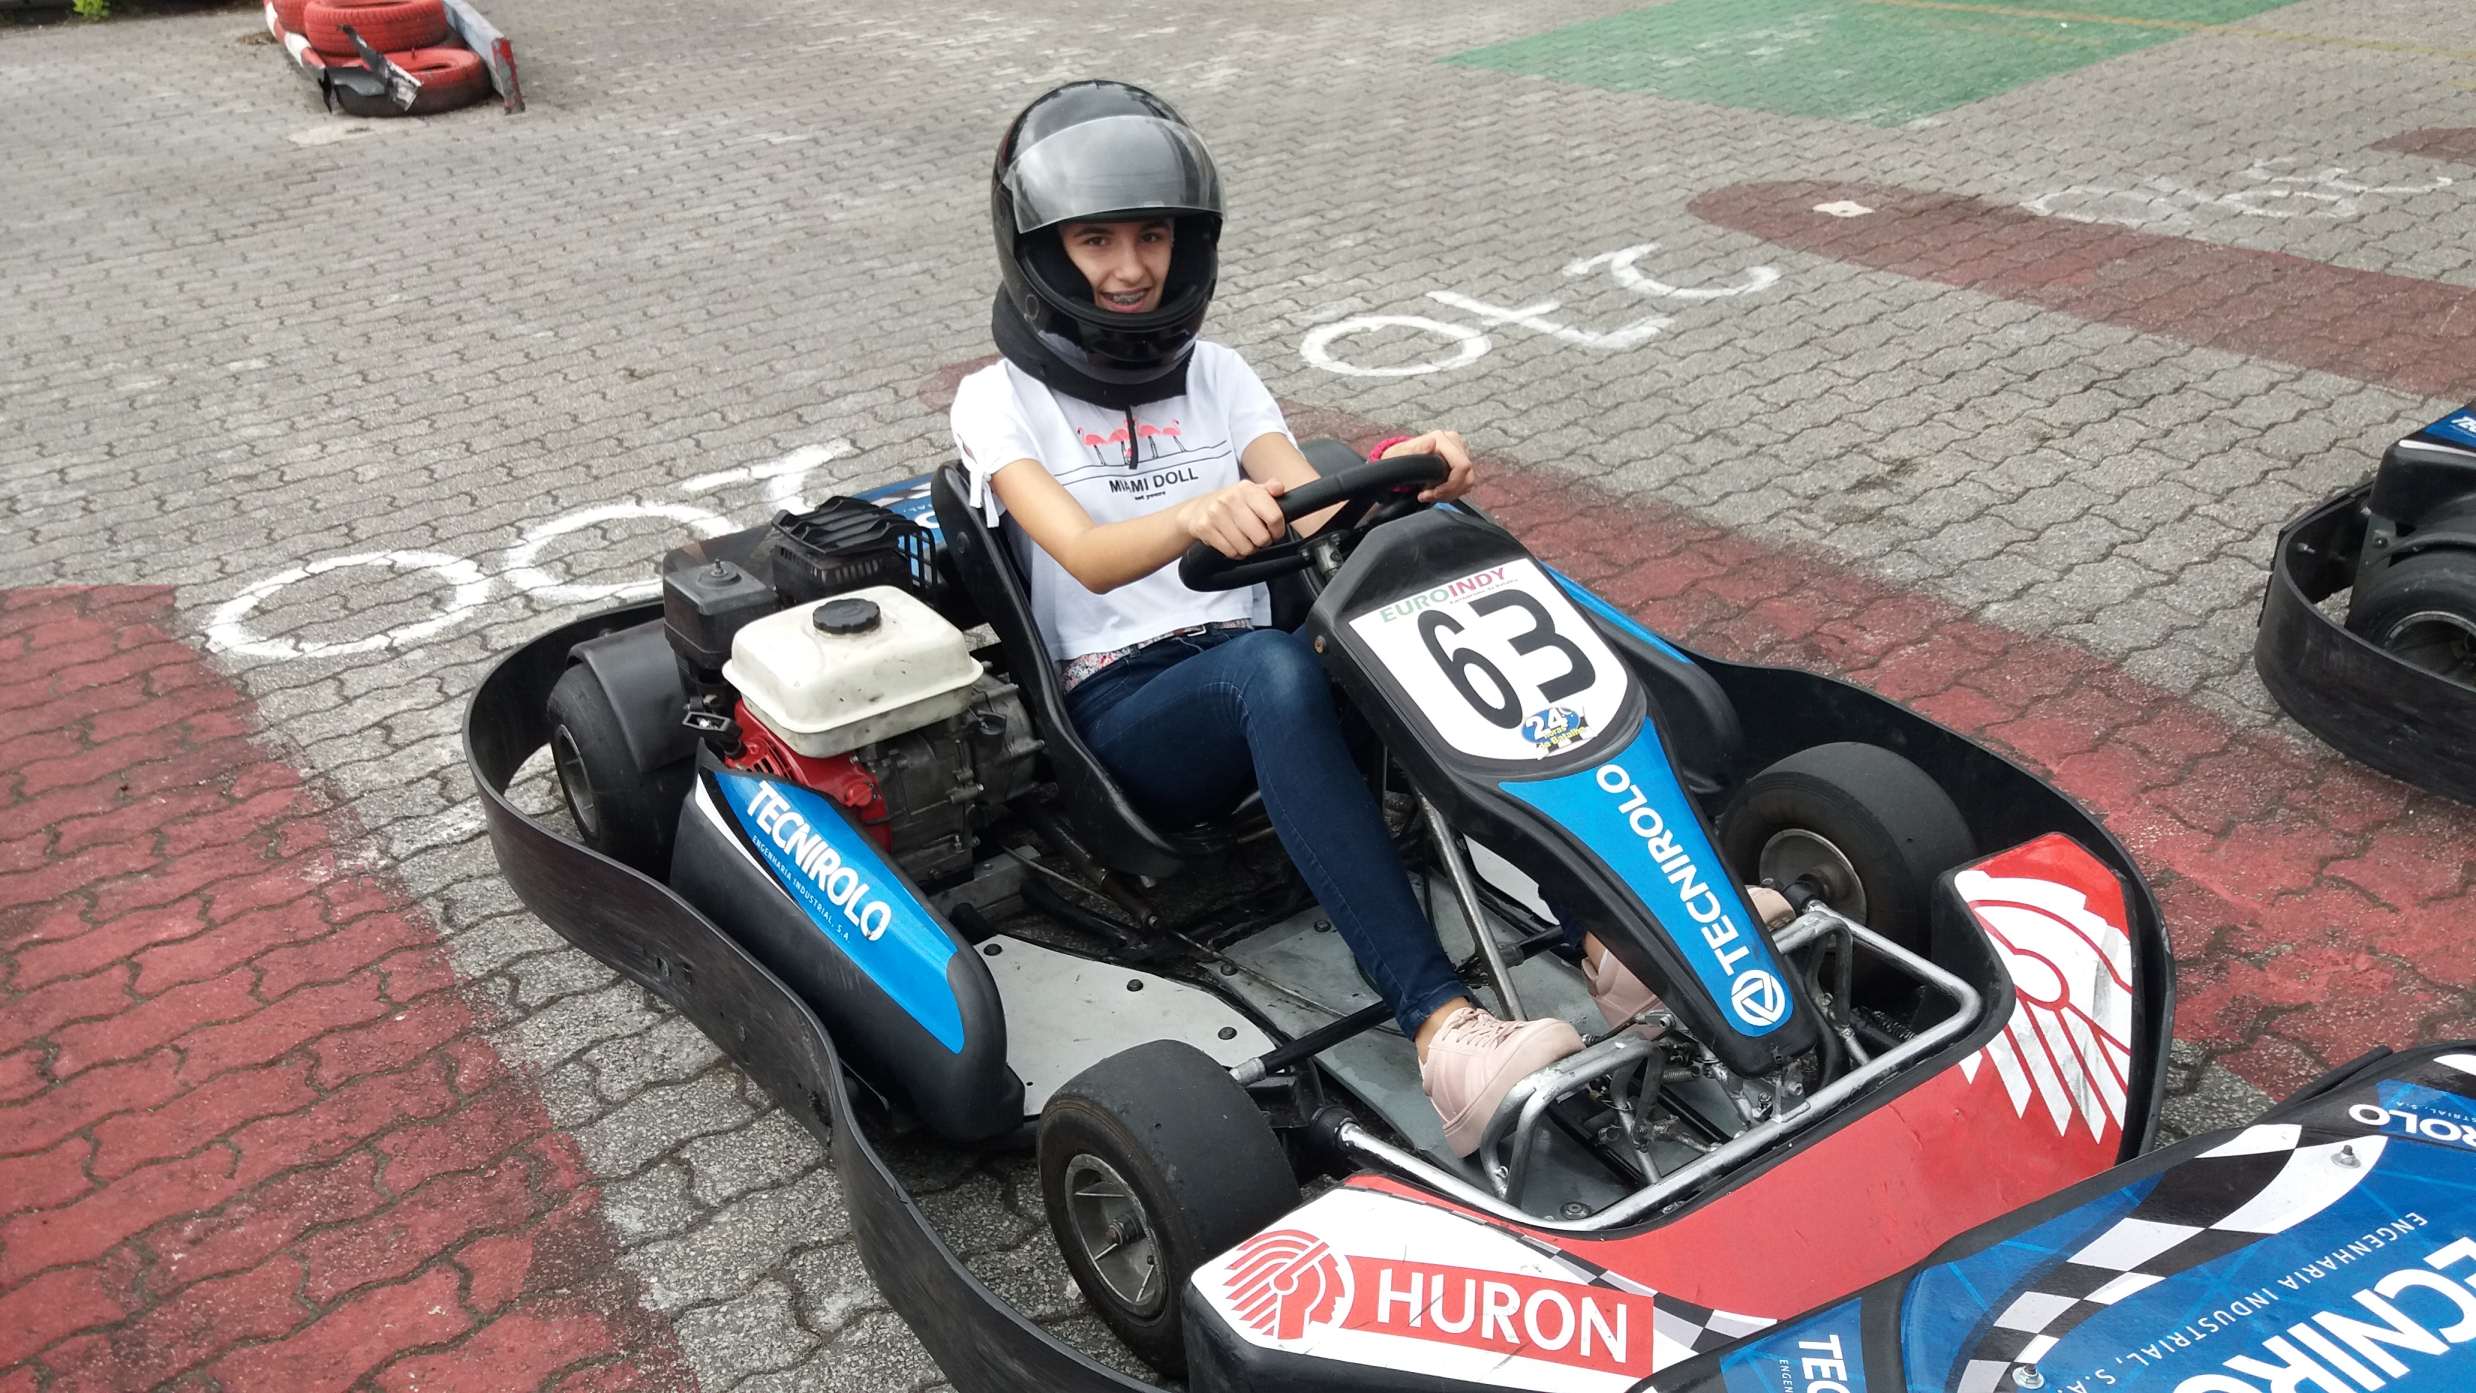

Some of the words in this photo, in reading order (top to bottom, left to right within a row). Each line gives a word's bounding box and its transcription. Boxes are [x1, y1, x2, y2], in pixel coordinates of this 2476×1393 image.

[1109, 478, 1150, 493] MIAMI
[1152, 467, 1199, 488] DOLL
[1417, 589, 1596, 729] 63
[1525, 707, 1568, 739] 24
[746, 780, 892, 942] TECNIROLO
[752, 835, 791, 881] ENGENHARIA
[793, 879, 834, 928] INDUSTRIAL,
[1596, 764, 1750, 976] TECNIROLO
[2277, 1212, 2429, 1290] ENGENHARIA
[1376, 1268, 1629, 1363] HURON
[2114, 1287, 2279, 1367] INDUSTRIAL,
[2172, 1236, 2476, 1393] CNIR
